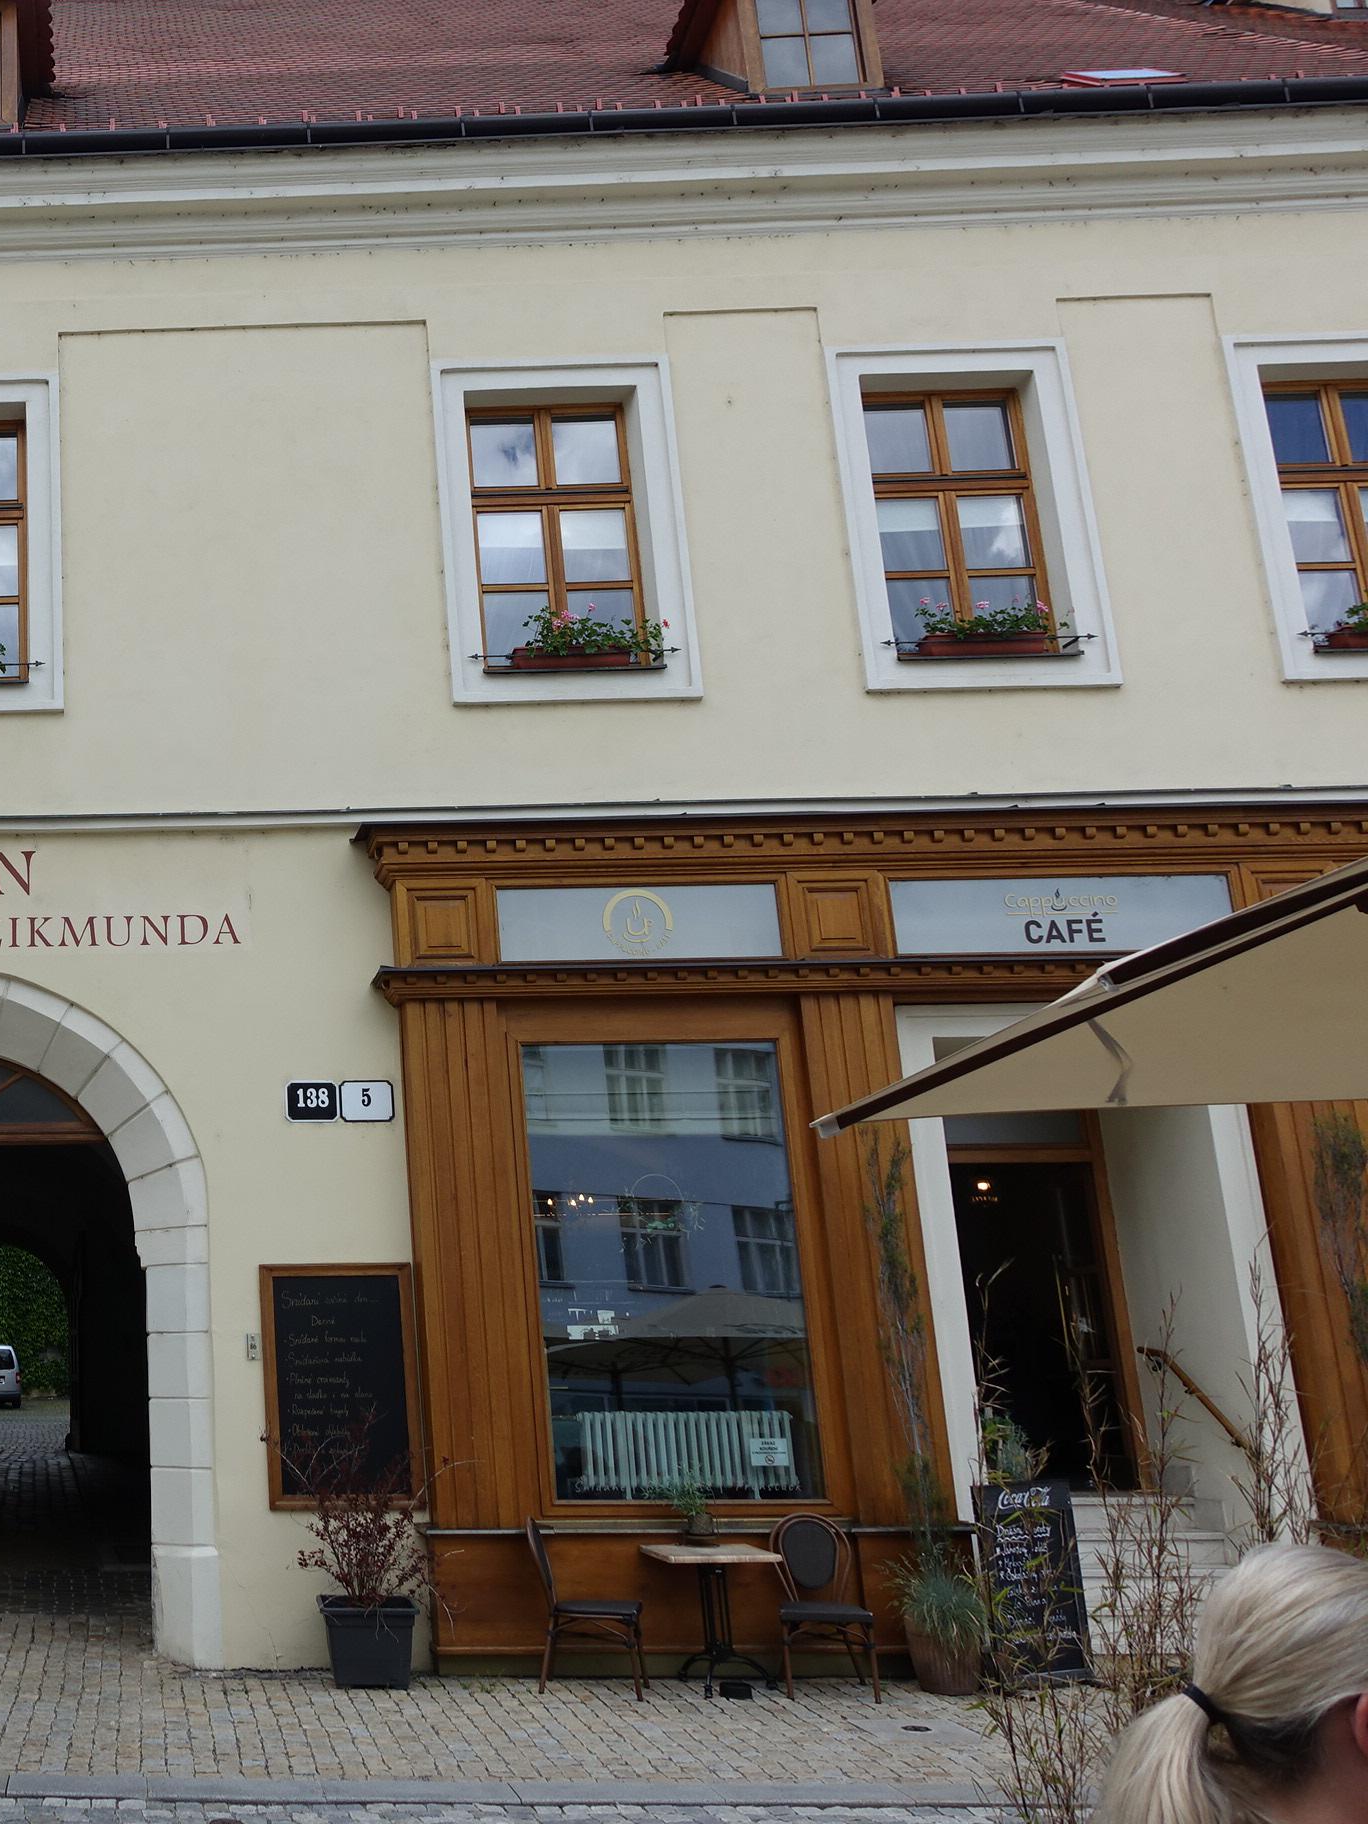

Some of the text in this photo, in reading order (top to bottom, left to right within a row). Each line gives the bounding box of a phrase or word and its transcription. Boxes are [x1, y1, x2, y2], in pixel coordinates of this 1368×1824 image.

[1004, 893, 1118, 918] Cappuccino
[1024, 911, 1106, 944] CAFÉ
[296, 1087, 330, 1108] 138
[361, 1087, 372, 1107] 5
